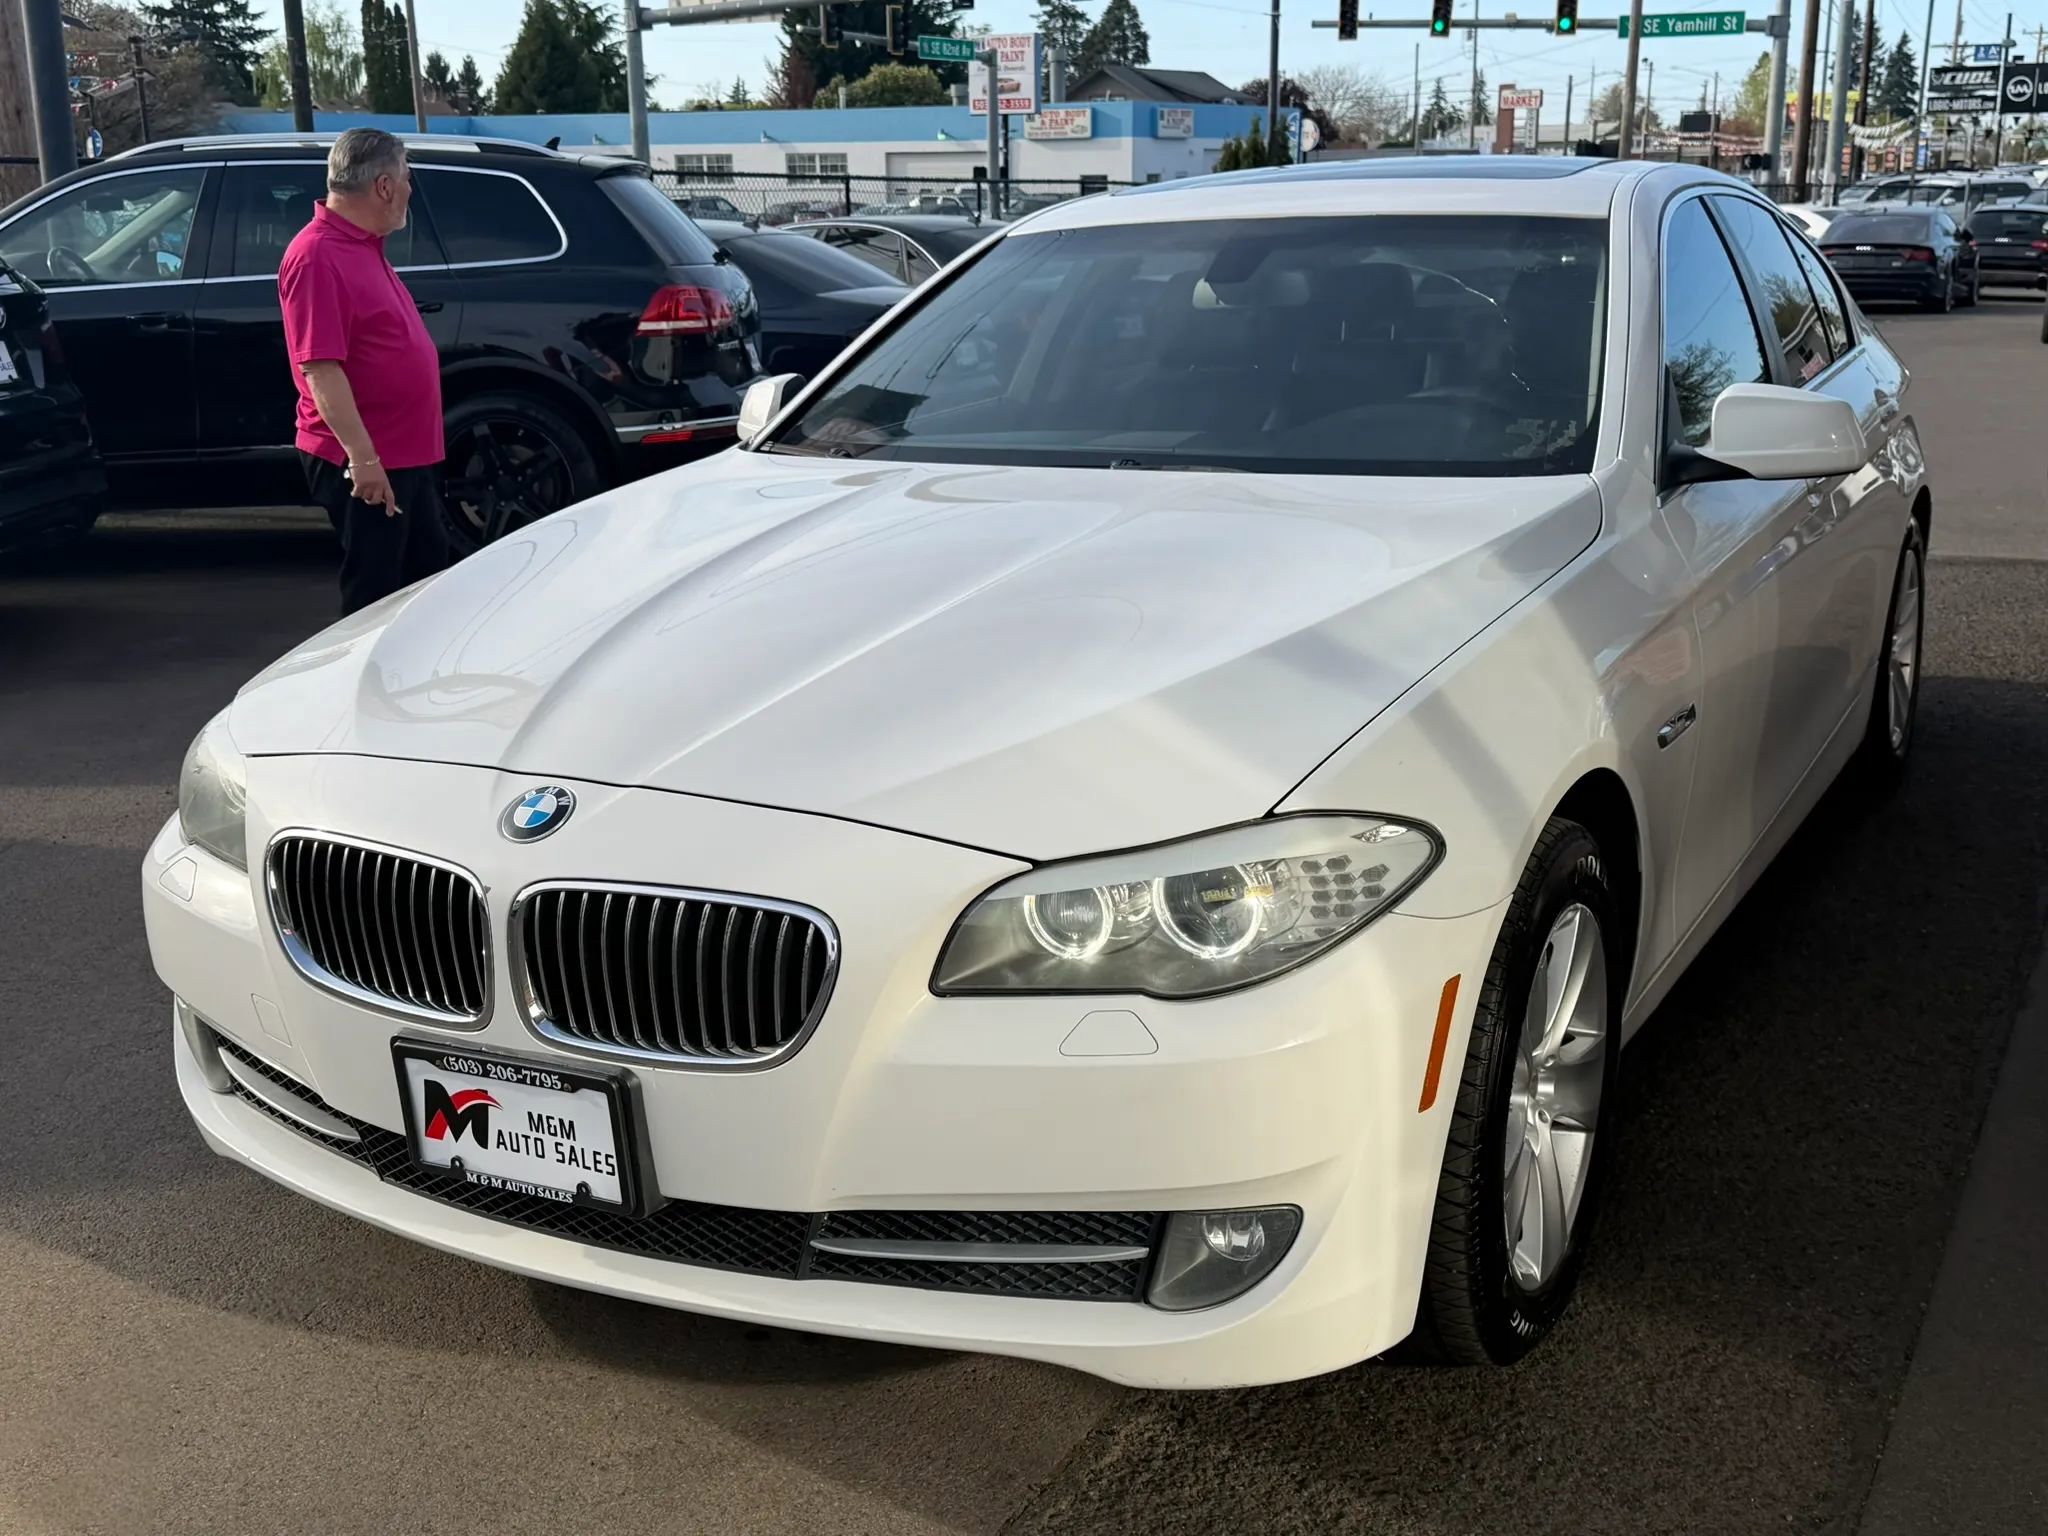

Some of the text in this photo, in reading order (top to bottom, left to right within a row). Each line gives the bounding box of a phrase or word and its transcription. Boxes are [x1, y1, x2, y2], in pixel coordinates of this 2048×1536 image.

[1643, 15, 1737, 34] SE Yamhill St
[931, 41, 941, 55] SE
[1010, 36, 1032, 48] BODY
[1000, 50, 1025, 62] PAINT
[1503, 95, 1539, 107] MARKET
[525, 786, 570, 805] BMW
[443, 1055, 562, 1090] (503) 206-7795
[526, 1110, 577, 1142] M&M
[496, 1128, 616, 1177] AUTO SALES
[466, 1172, 574, 1204] M & M AUTO SALES
